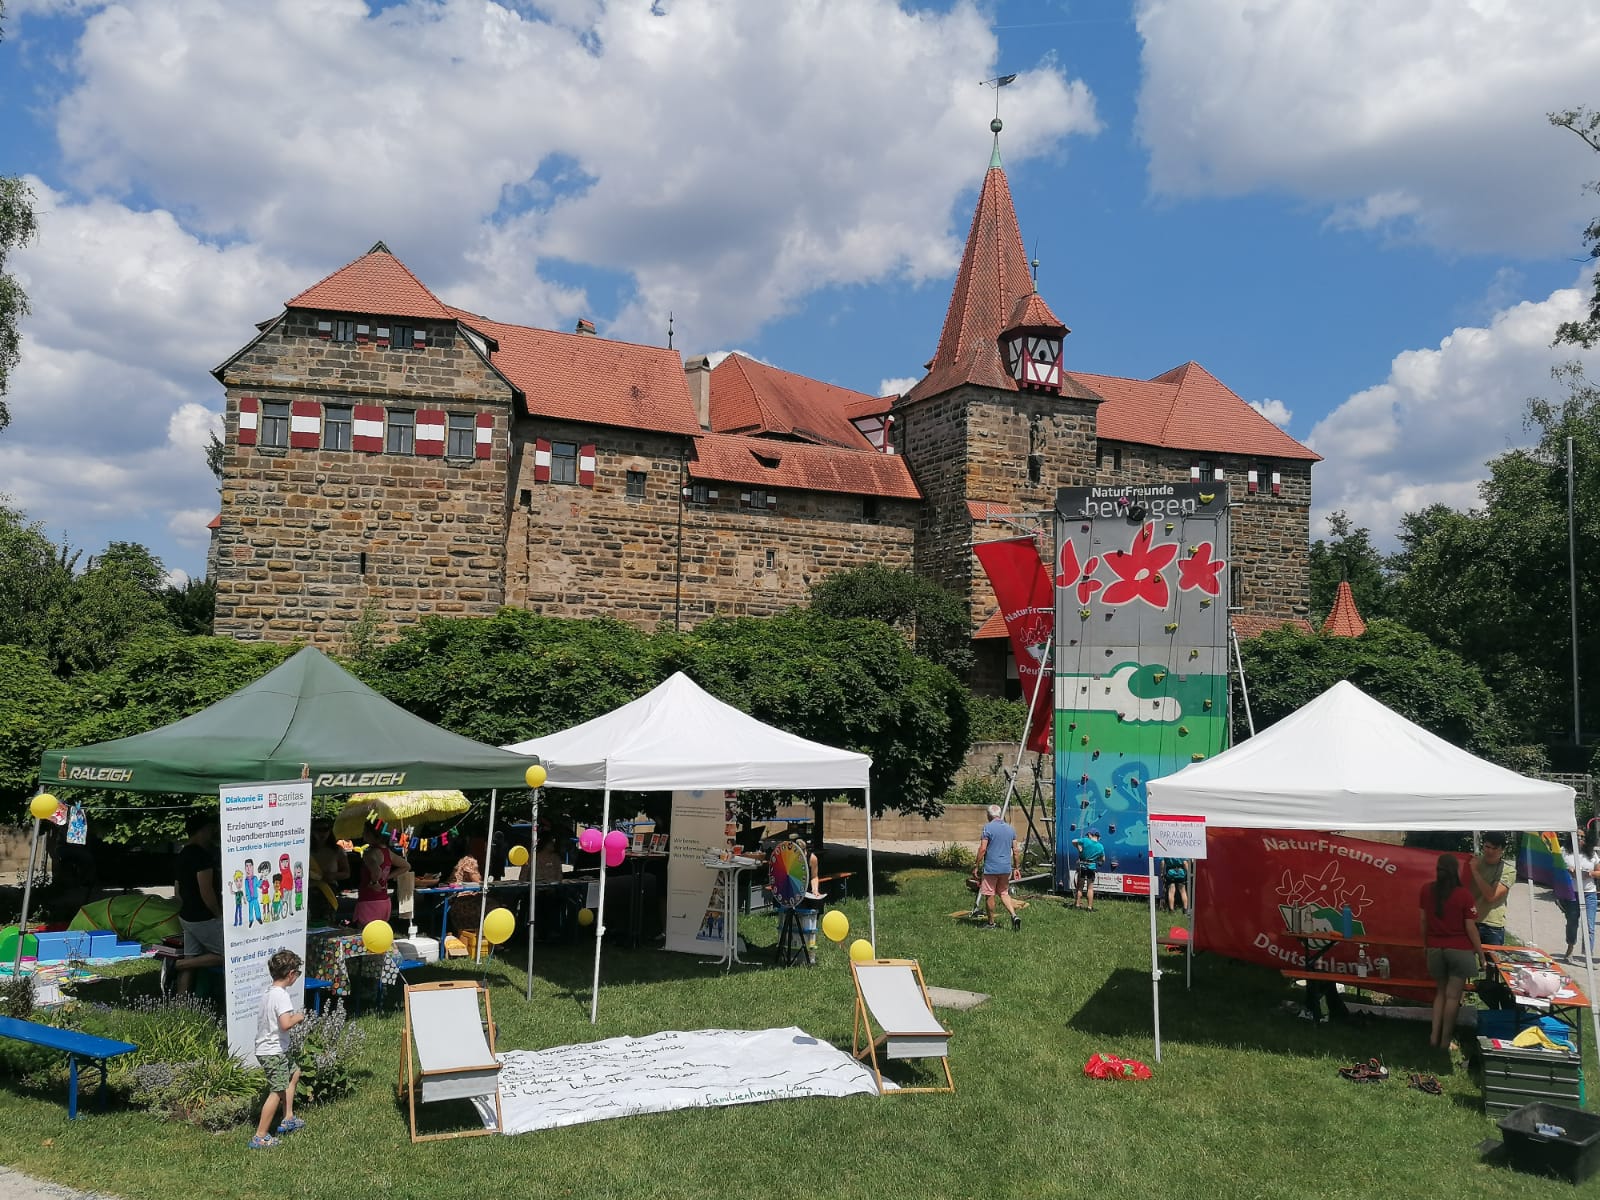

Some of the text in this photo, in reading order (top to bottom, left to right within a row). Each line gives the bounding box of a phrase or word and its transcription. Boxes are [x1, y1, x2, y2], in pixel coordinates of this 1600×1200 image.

[1091, 484, 1174, 498] NaturFreunde
[69, 767, 134, 782] RALEIGH
[314, 772, 406, 787] RALEIGH
[225, 794, 256, 804] Diakonie
[277, 792, 304, 801] caritas
[227, 818, 284, 831] Erziehungs- und
[227, 827, 305, 843] Jugendberatungsstelle
[1262, 838, 1398, 874] NaturFreunde
[230, 956, 242, 964] Wir
[243, 952, 256, 960] sind
[257, 950, 267, 958] für
